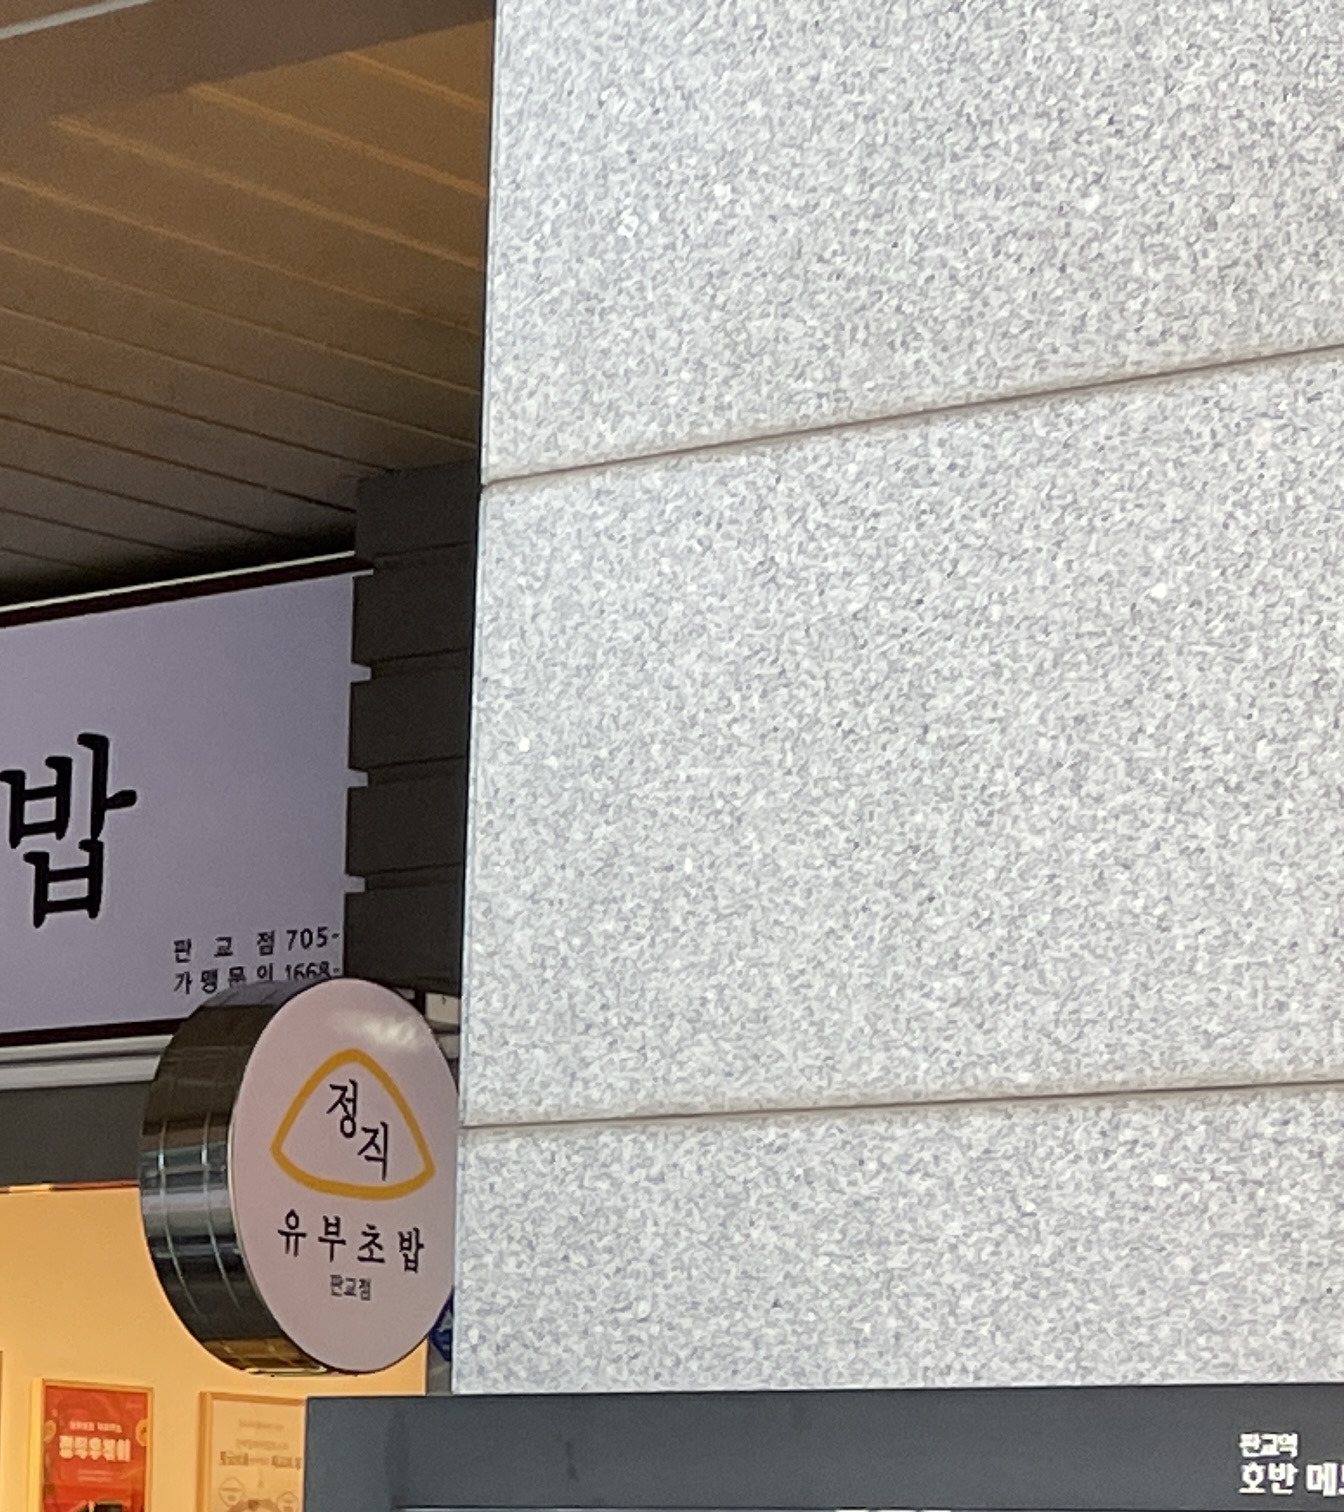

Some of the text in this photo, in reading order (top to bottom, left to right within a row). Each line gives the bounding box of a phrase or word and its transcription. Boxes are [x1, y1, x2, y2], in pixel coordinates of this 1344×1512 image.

[326, 1078, 391, 1182] 정직
[277, 1208, 425, 1273] 유부초밥
[1238, 1462, 1344, 1497] 호반 메
